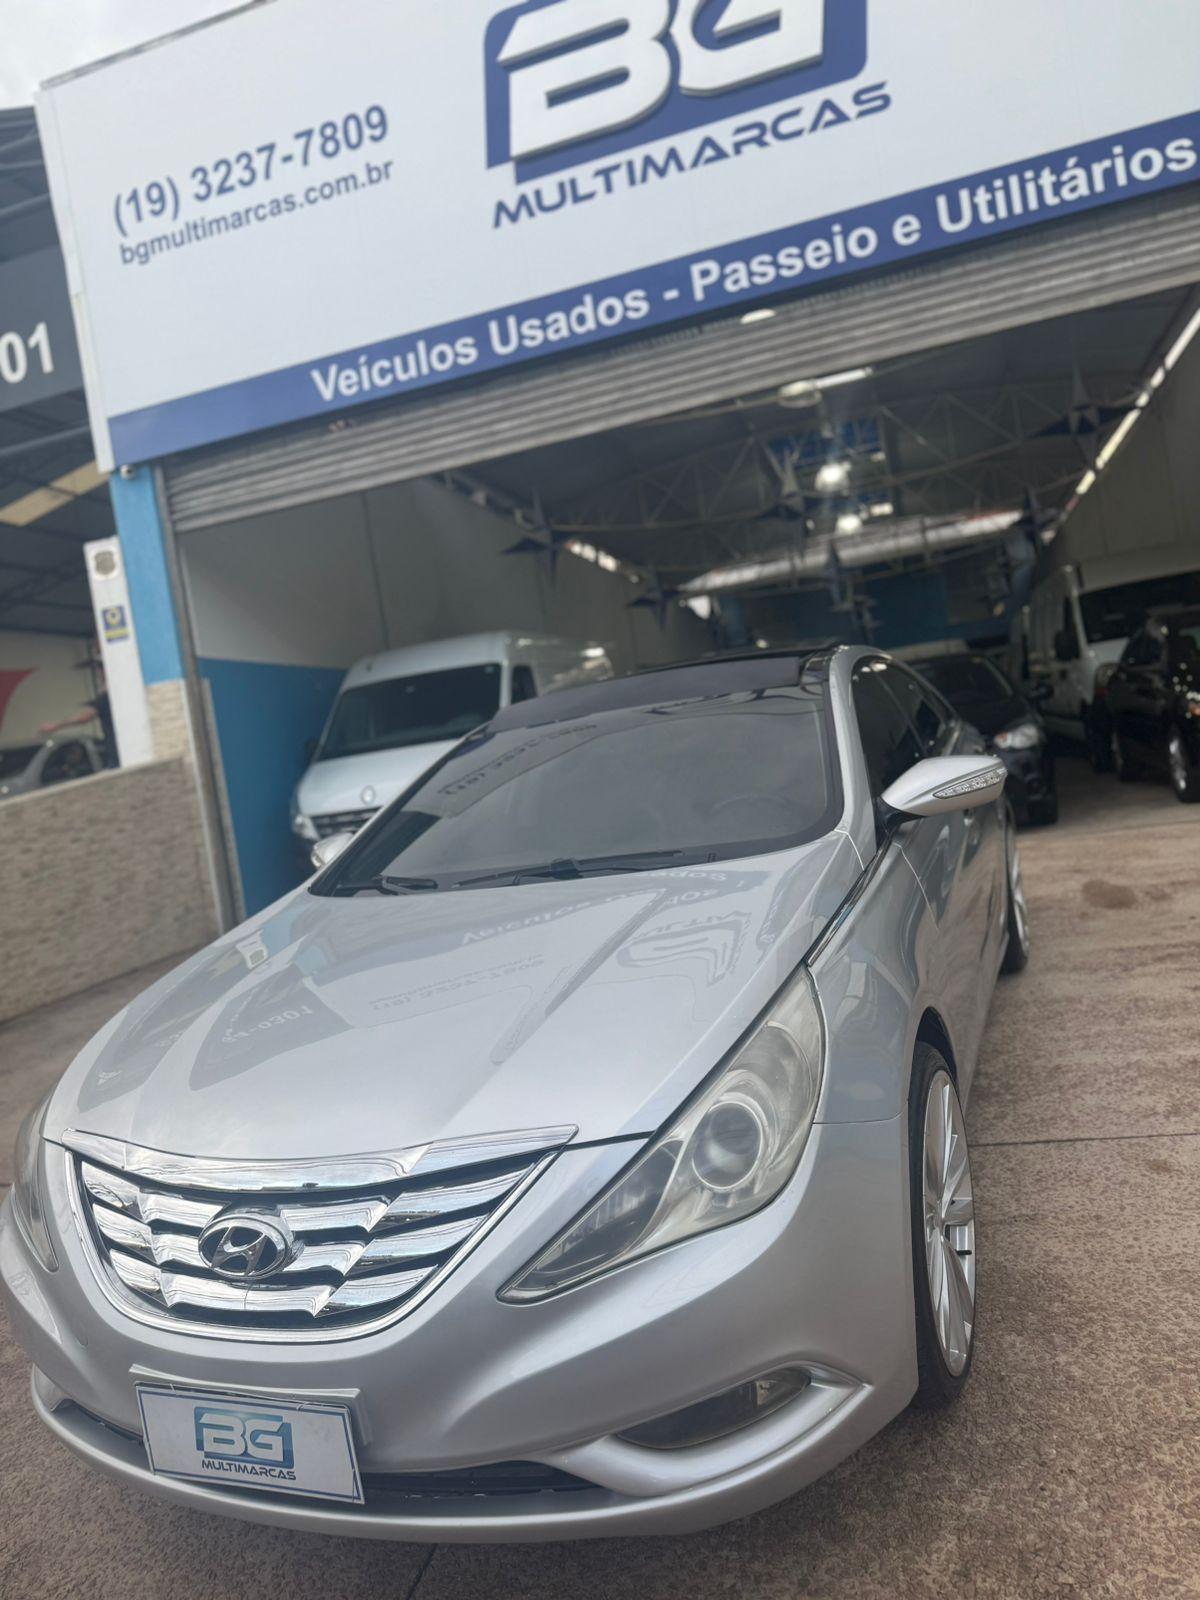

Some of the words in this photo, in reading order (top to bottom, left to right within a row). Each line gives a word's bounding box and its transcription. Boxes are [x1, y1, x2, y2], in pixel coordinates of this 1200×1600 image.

[497, 0, 823, 156] BG
[113, 176, 181, 236] (19)
[190, 105, 389, 203] 3237-7809
[119, 158, 394, 266] bgmultimarcas.com.br
[492, 81, 892, 229] MULTIMARCAS
[311, 332, 480, 402] Veículos
[488, 287, 651, 357] Usados
[690, 224, 878, 302] Passeio
[892, 214, 921, 246] e
[936, 136, 1197, 234] Utilitários
[199, 1413, 284, 1461] BG
[201, 1459, 297, 1481] MULTIMARCAS
